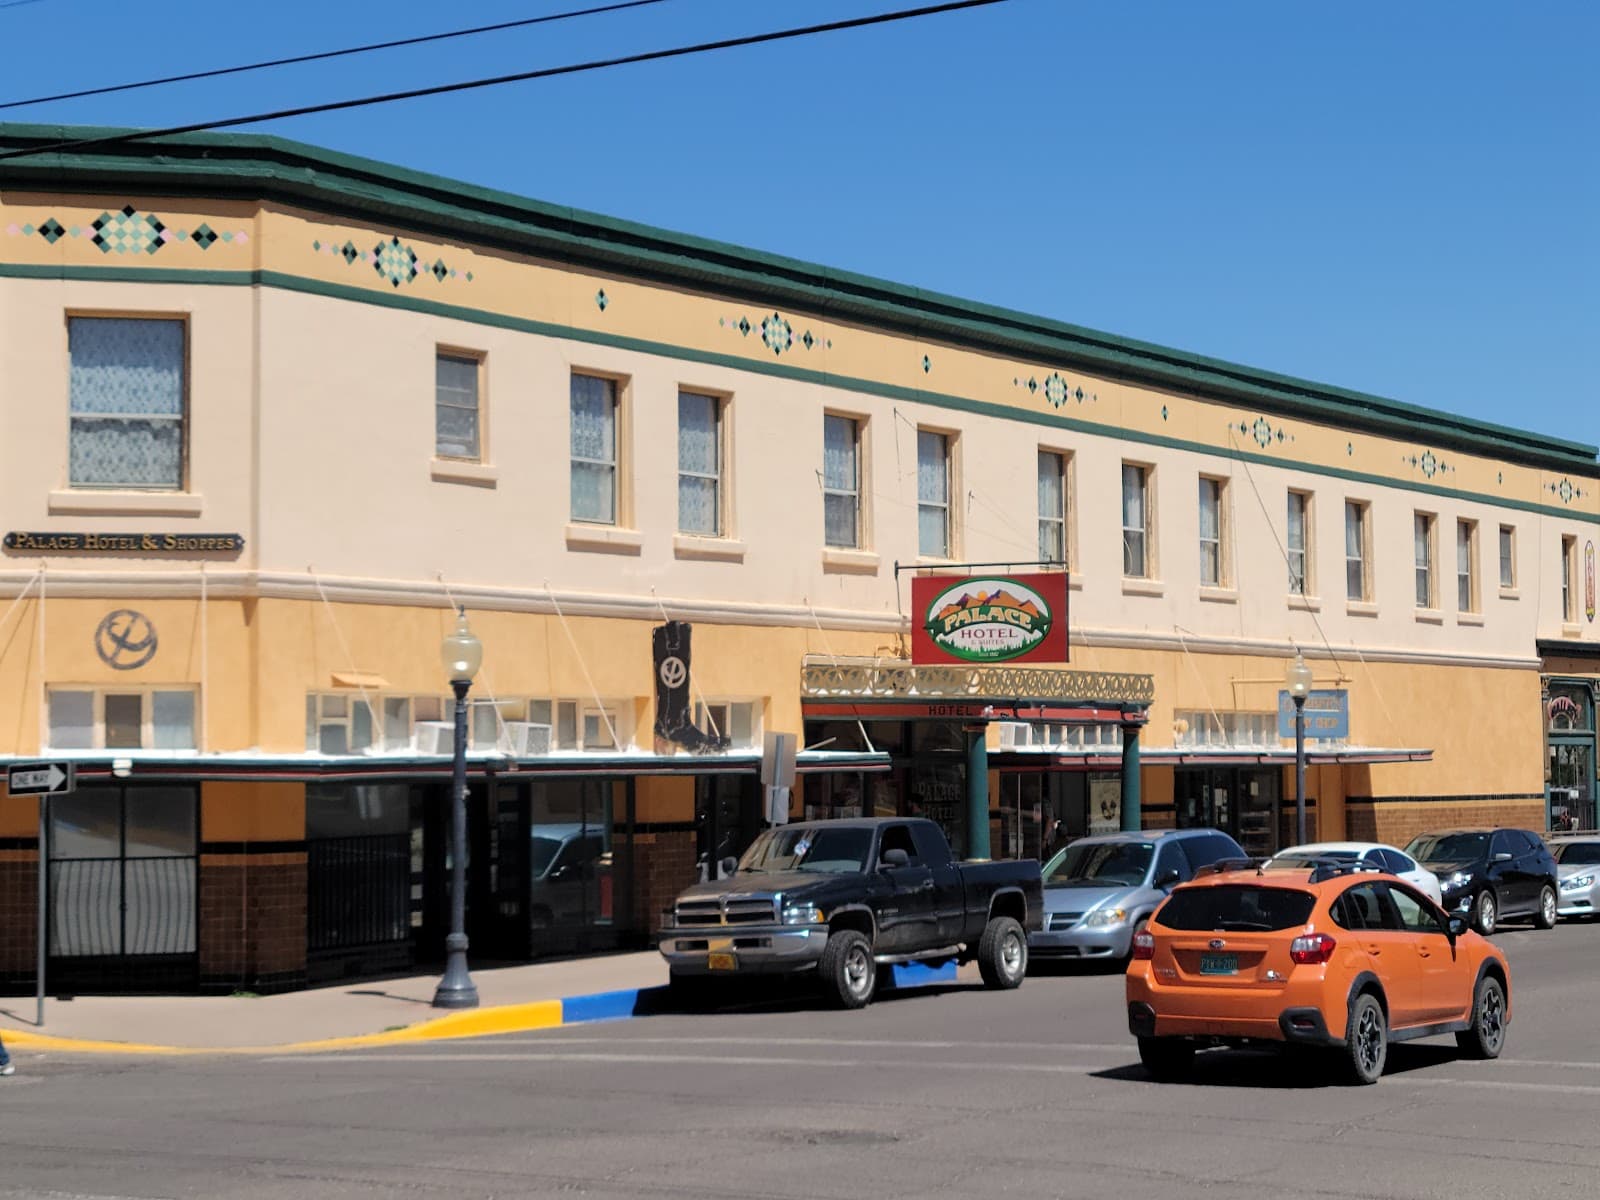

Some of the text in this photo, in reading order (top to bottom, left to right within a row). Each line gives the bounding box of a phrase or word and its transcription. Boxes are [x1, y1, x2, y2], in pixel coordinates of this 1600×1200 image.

[14, 532, 235, 550] PALACE HOTEL & SHOPPES
[944, 607, 1032, 632] PALACE
[961, 628, 1018, 639] HOTEL
[928, 705, 973, 716] HOTEL
[15, 772, 49, 786] ONE WAY
